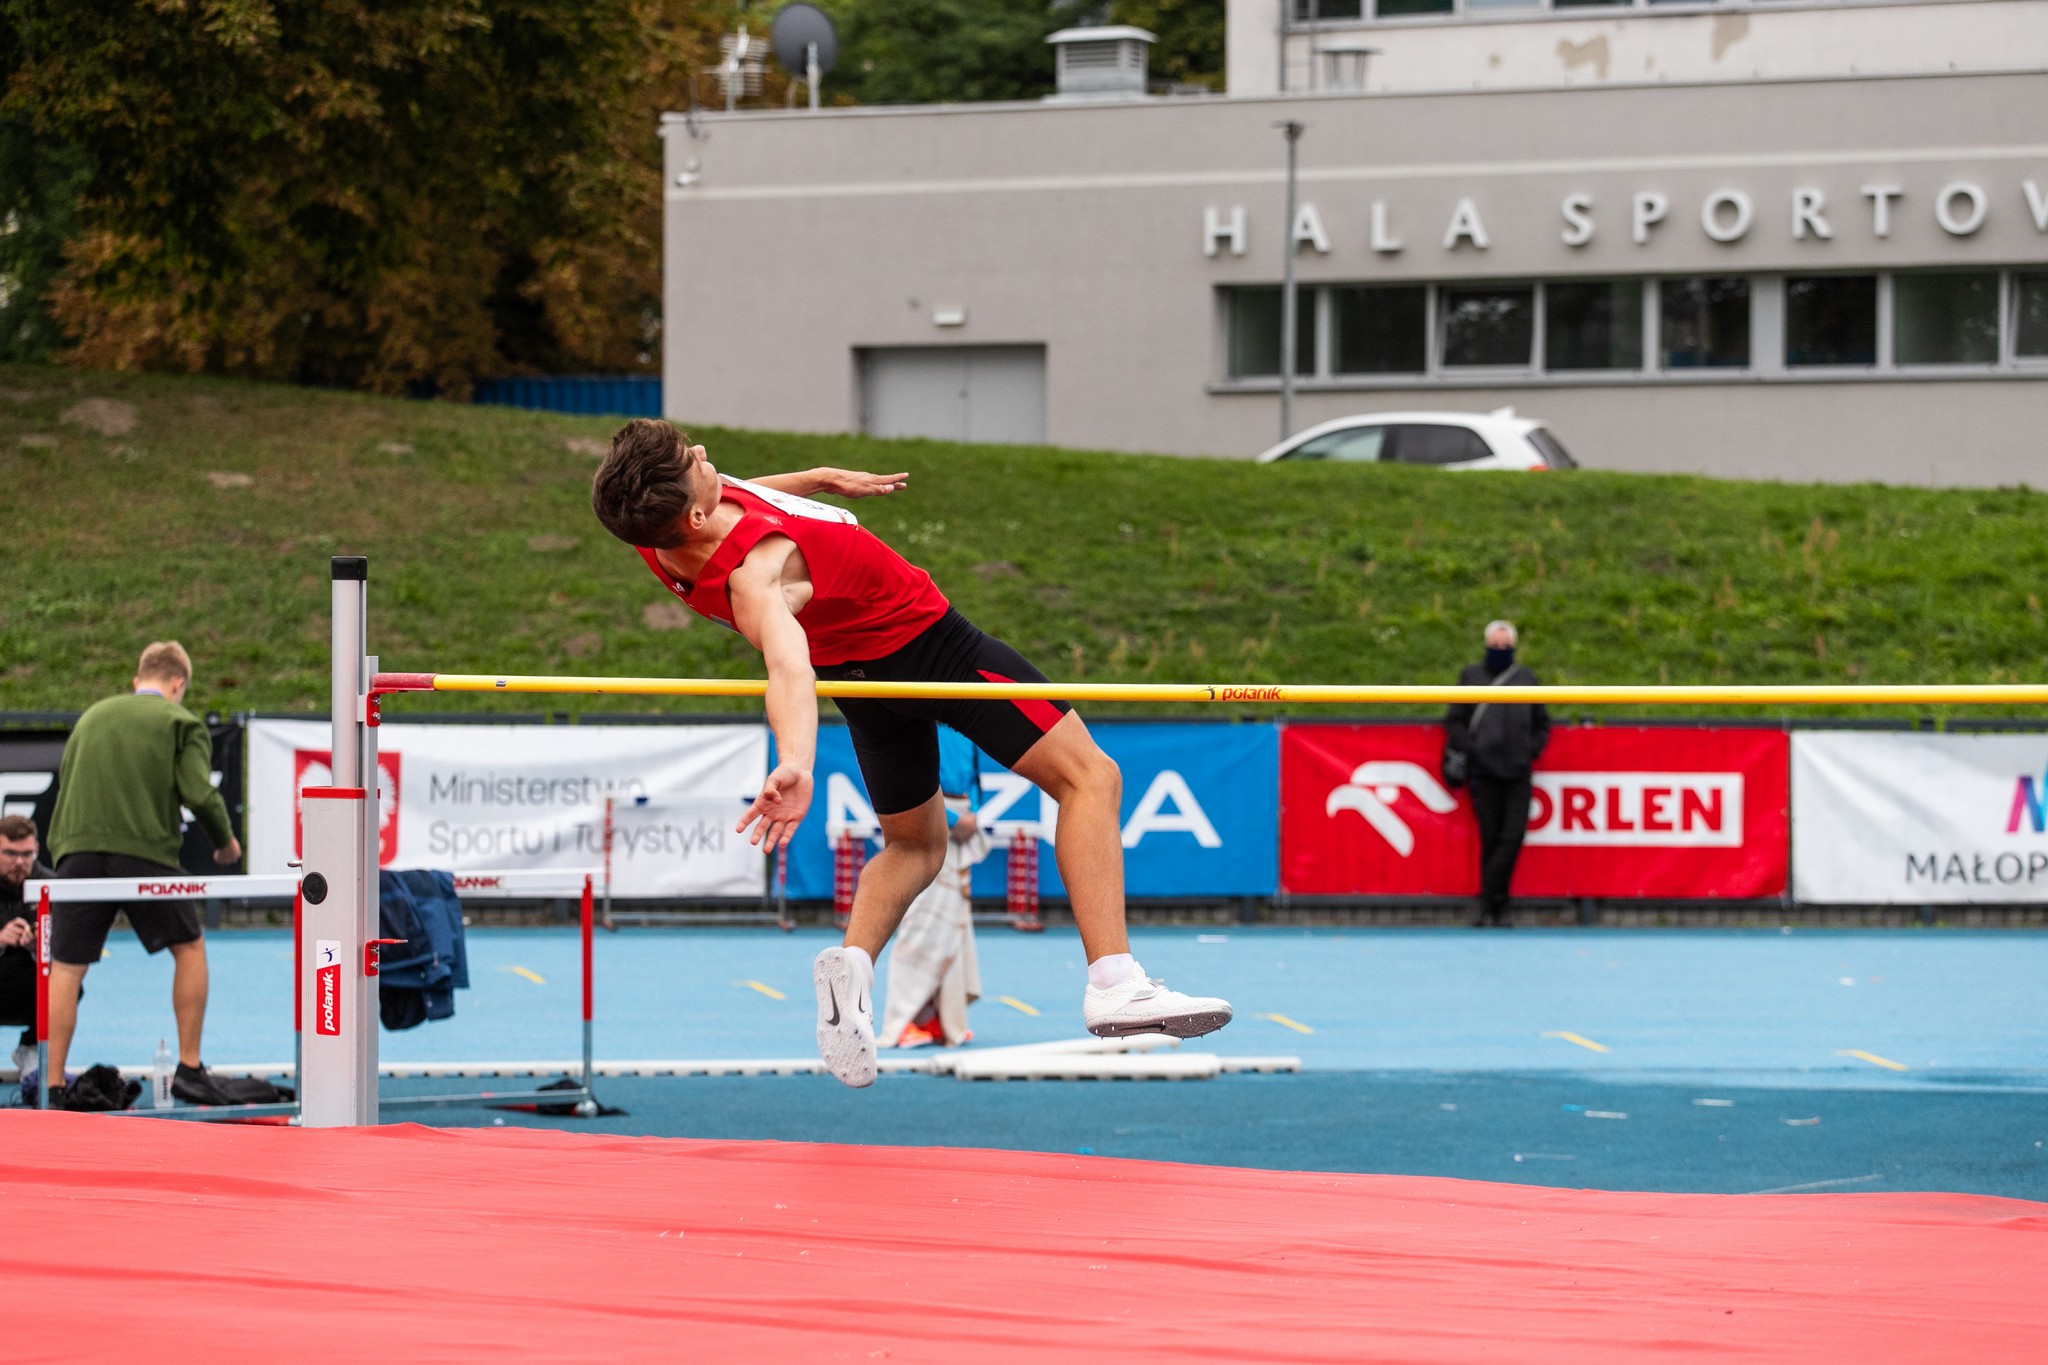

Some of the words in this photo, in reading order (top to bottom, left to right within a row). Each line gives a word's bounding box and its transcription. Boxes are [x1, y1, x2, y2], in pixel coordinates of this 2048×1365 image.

[1203, 197, 1490, 257] HALA
[1222, 687, 1282, 701] polanik
[428, 820, 544, 860] Sportu
[552, 823, 561, 851] i
[138, 883, 207, 895] POLANIK
[322, 971, 336, 1032] polanik
